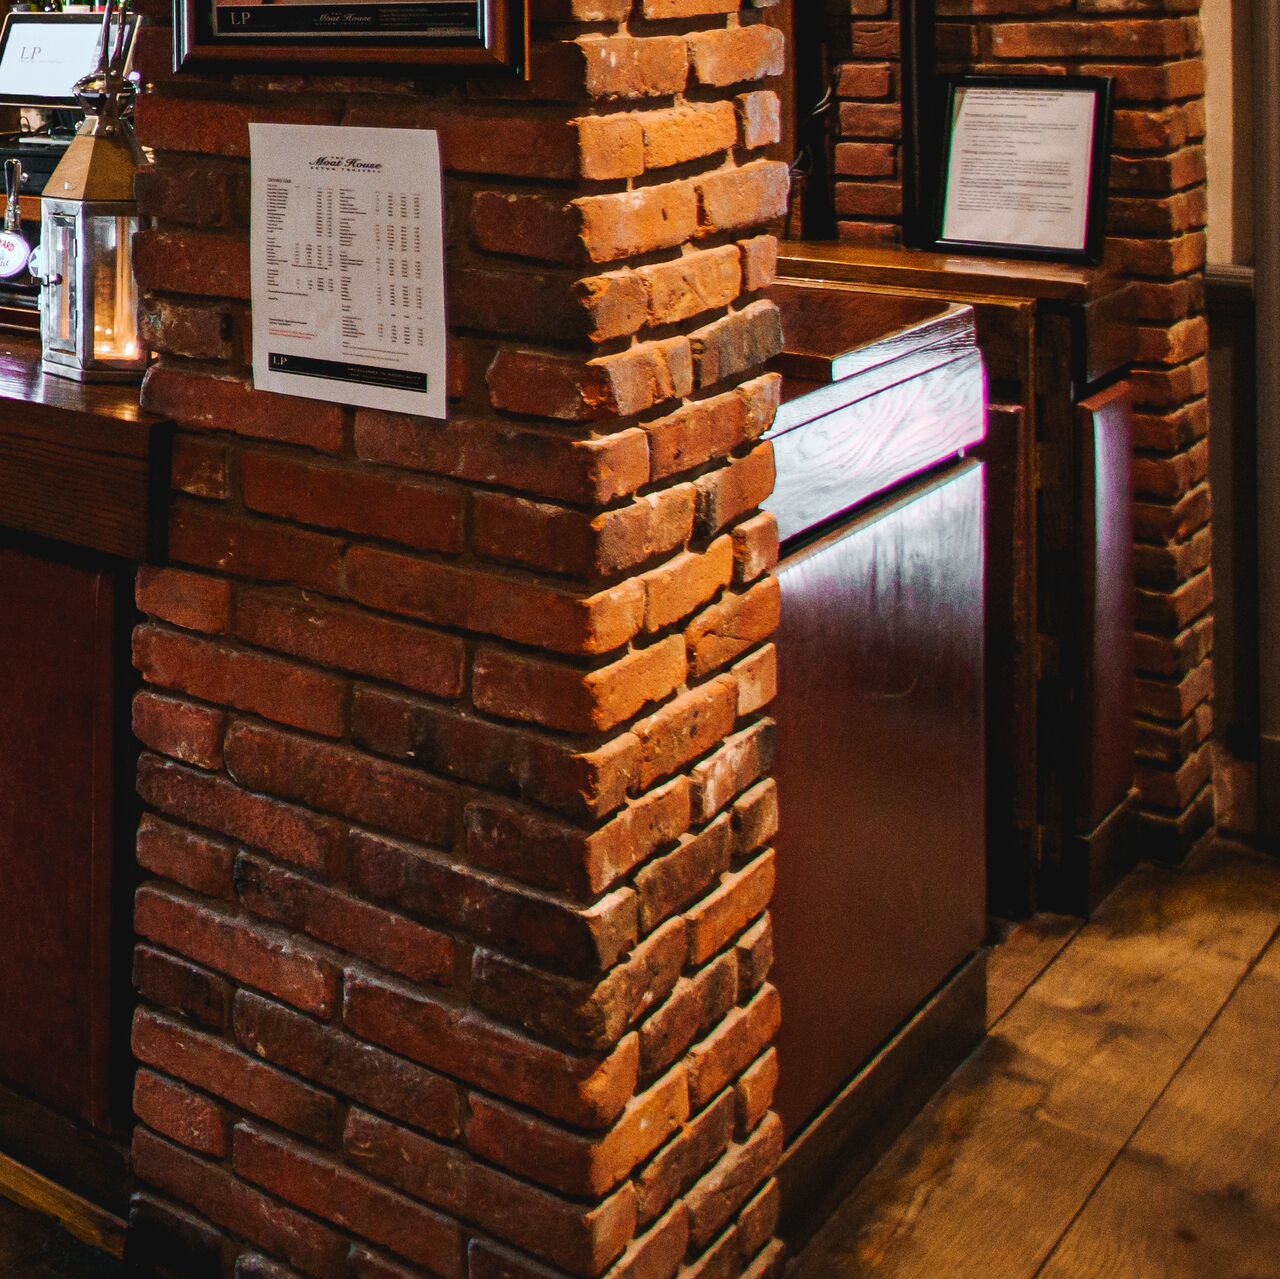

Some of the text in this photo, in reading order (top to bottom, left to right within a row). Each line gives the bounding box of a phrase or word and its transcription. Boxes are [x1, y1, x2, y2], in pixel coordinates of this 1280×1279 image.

[228, 11, 252, 25] LP
[20, 46, 43, 60] LP
[308, 156, 343, 168] Moat
[344, 158, 383, 170] House
[272, 355, 289, 367] LP
